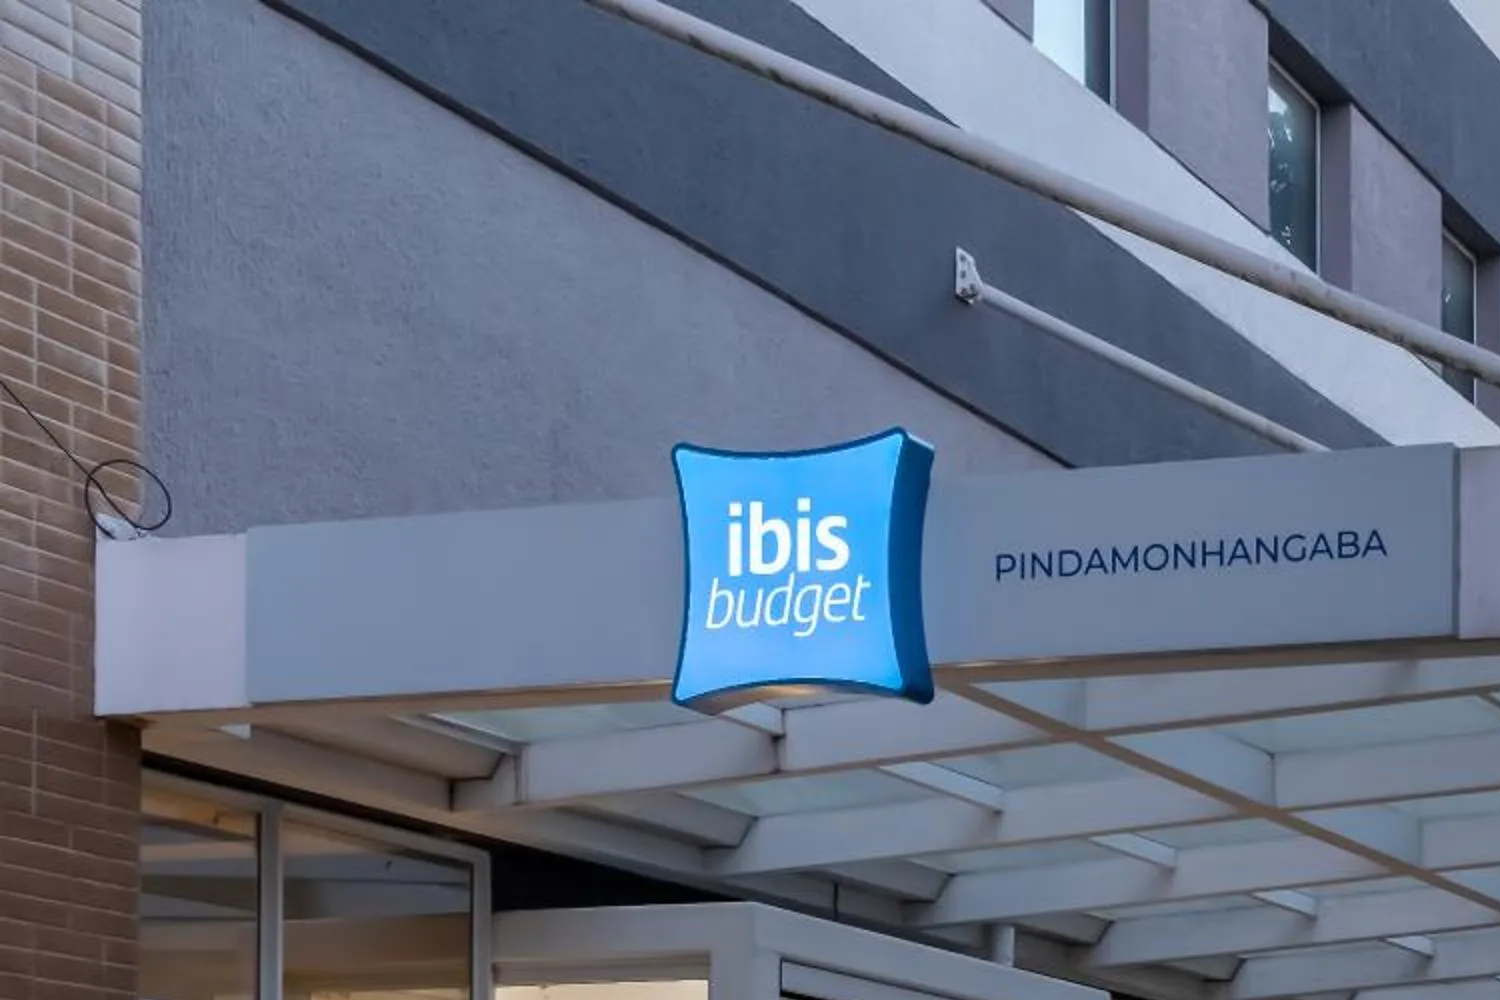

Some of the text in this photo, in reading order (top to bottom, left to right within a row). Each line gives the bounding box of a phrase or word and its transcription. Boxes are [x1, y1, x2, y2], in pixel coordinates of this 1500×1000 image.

[728, 497, 851, 577] ibis
[995, 528, 1388, 582] PINDAMONHANGABA
[705, 571, 871, 637] budget
